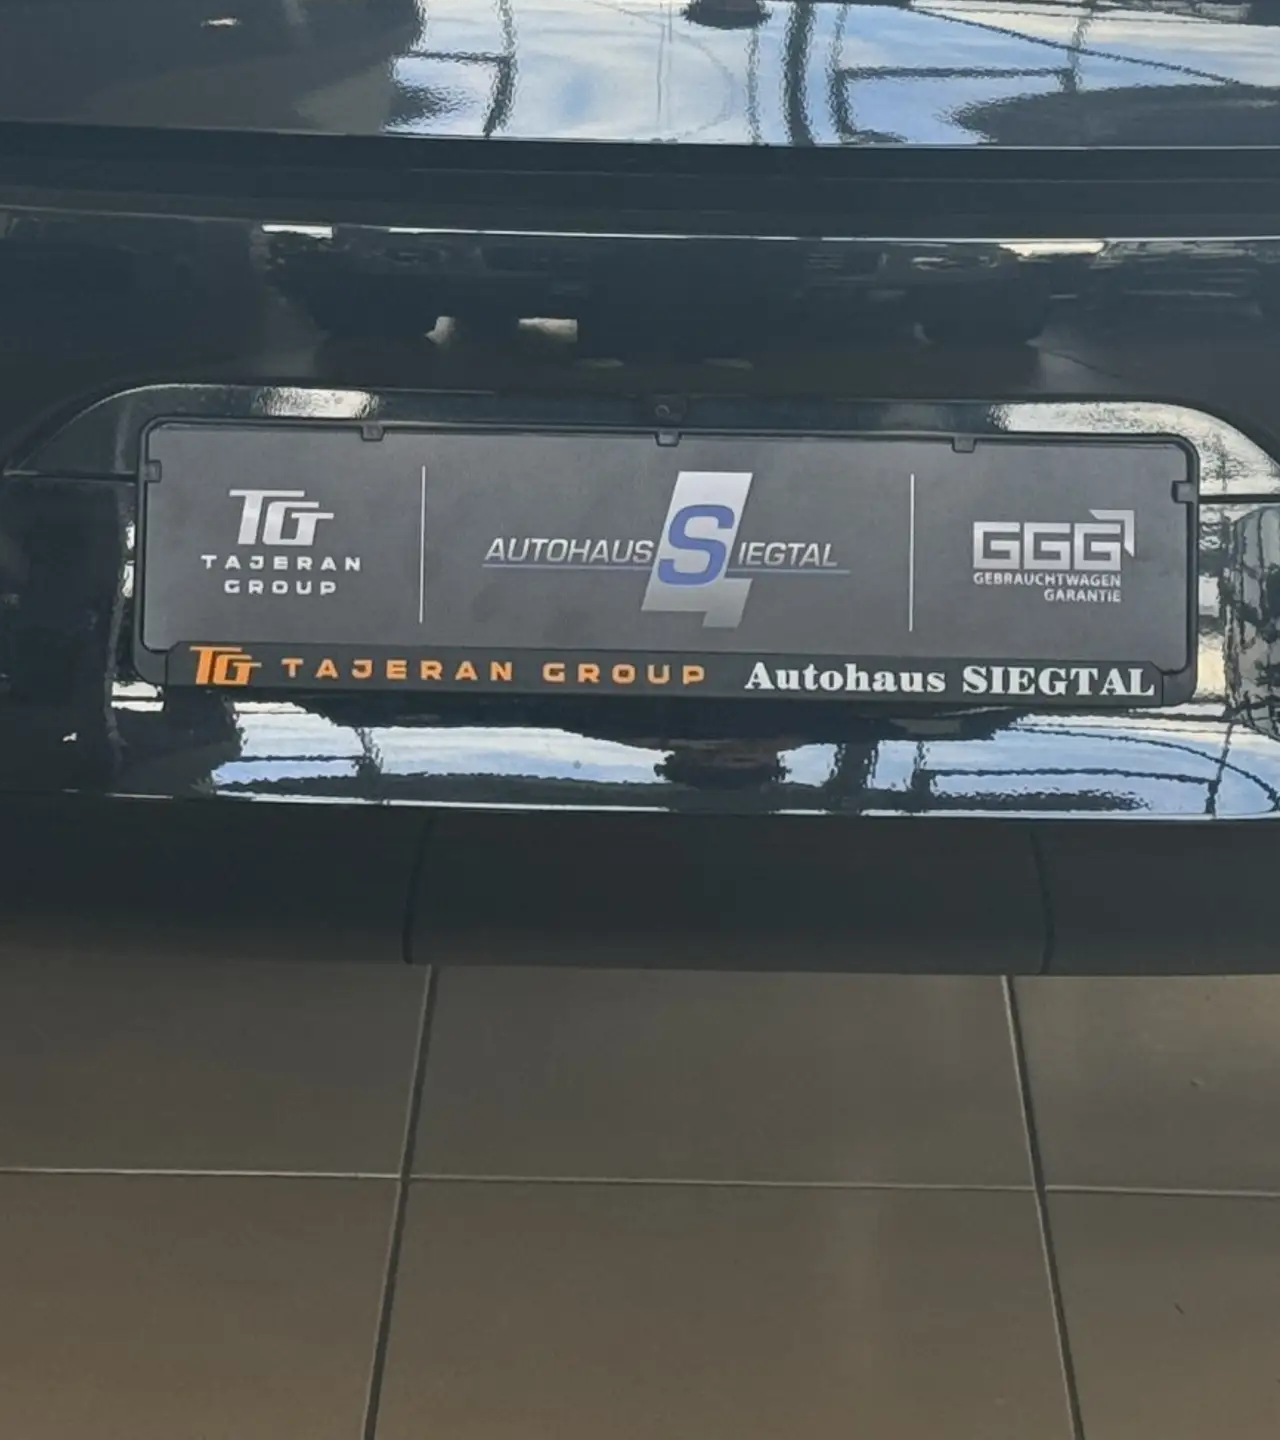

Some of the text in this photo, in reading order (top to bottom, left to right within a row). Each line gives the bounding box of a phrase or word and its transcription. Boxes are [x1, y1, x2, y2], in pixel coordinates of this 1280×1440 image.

[484, 538, 655, 565] AUTOHAUS
[973, 521, 1121, 570] GGG
[200, 554, 362, 571] TAJERAN
[223, 579, 337, 595] GROUP
[973, 572, 1121, 588] GEBRAUCHTWAGEN
[1043, 589, 1121, 603] GARANTIE
[282, 657, 513, 682] TAJERAN
[542, 662, 706, 685] GROUP
[744, 661, 947, 693] Autohaus
[962, 665, 1156, 697] SIEGTAL
